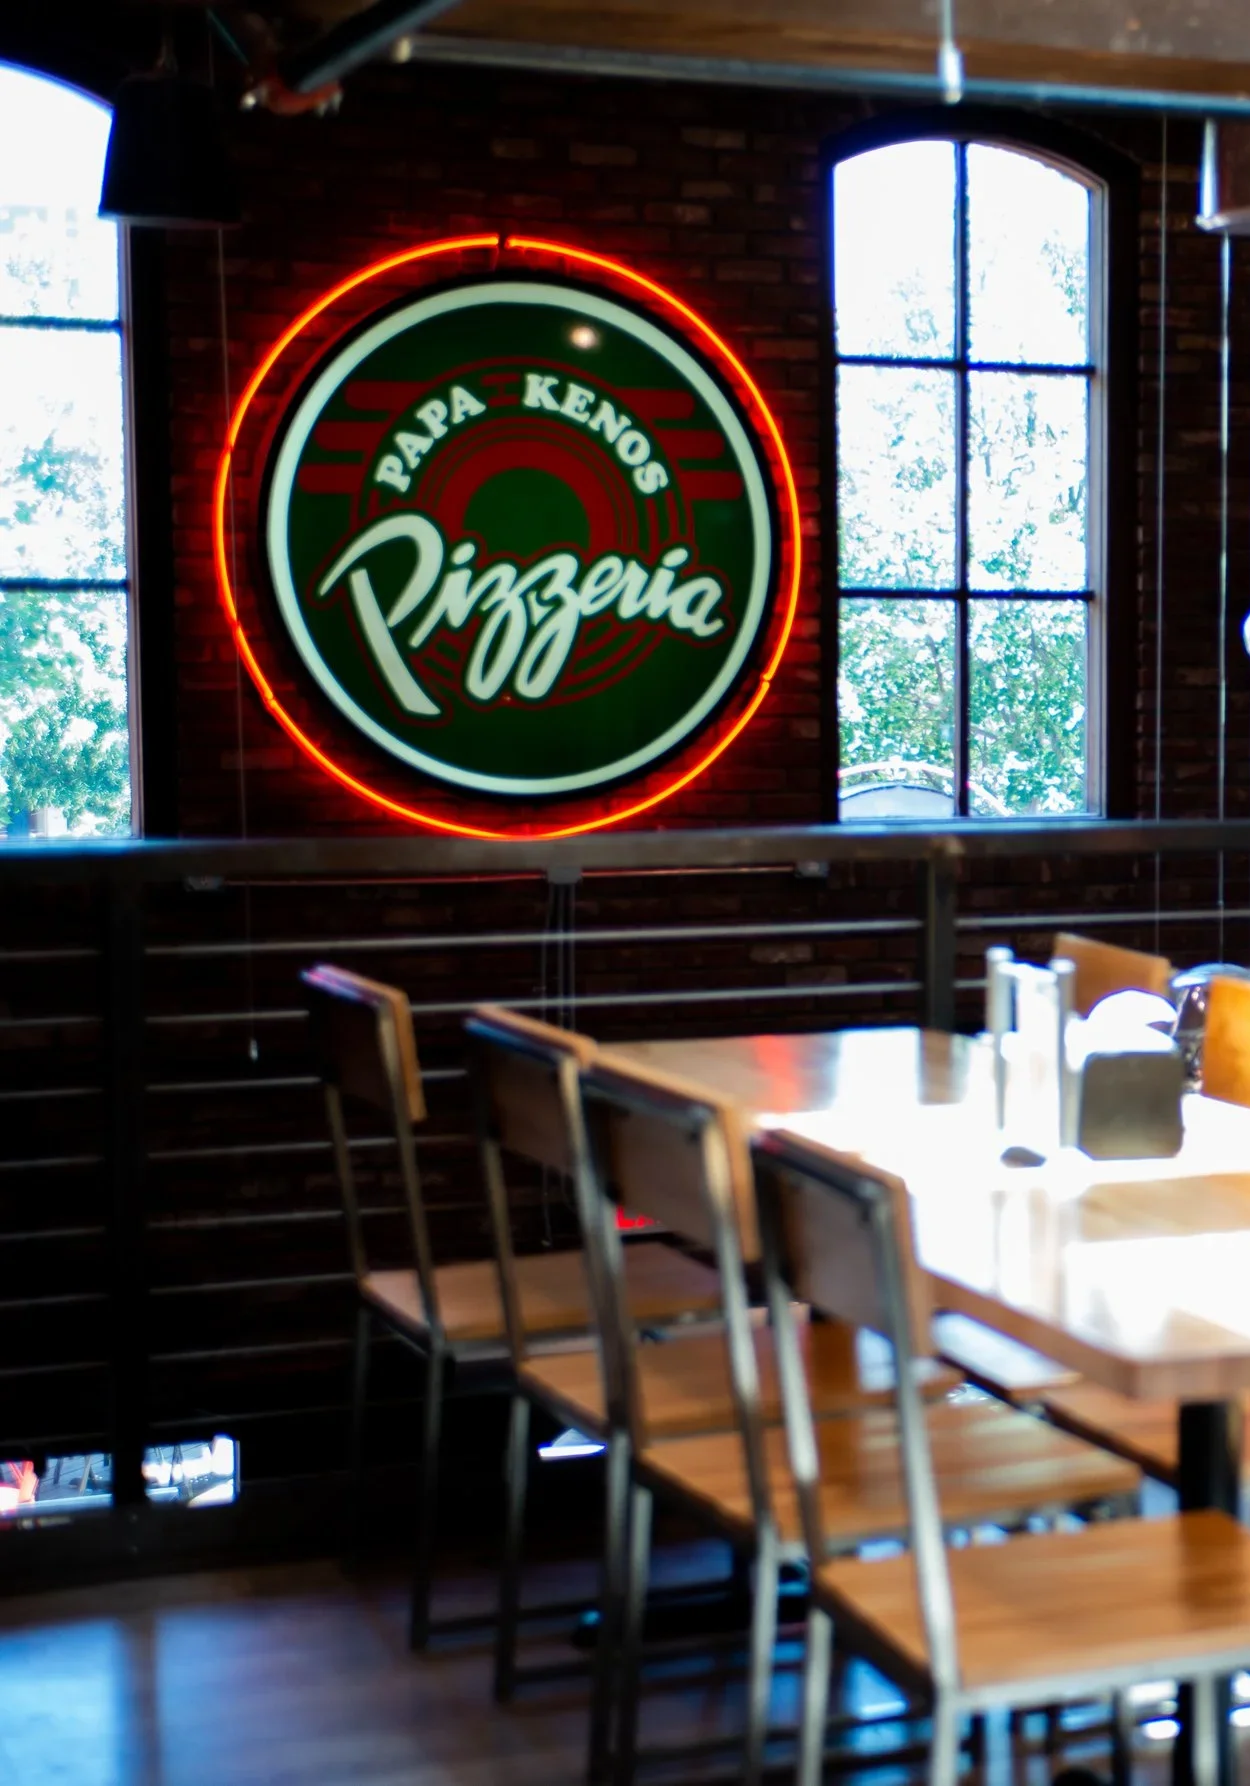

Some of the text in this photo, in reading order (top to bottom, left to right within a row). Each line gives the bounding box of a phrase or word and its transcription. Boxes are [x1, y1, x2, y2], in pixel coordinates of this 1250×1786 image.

[375, 373, 669, 494] PAPA KENOS
[319, 514, 724, 715] Pizzeria
